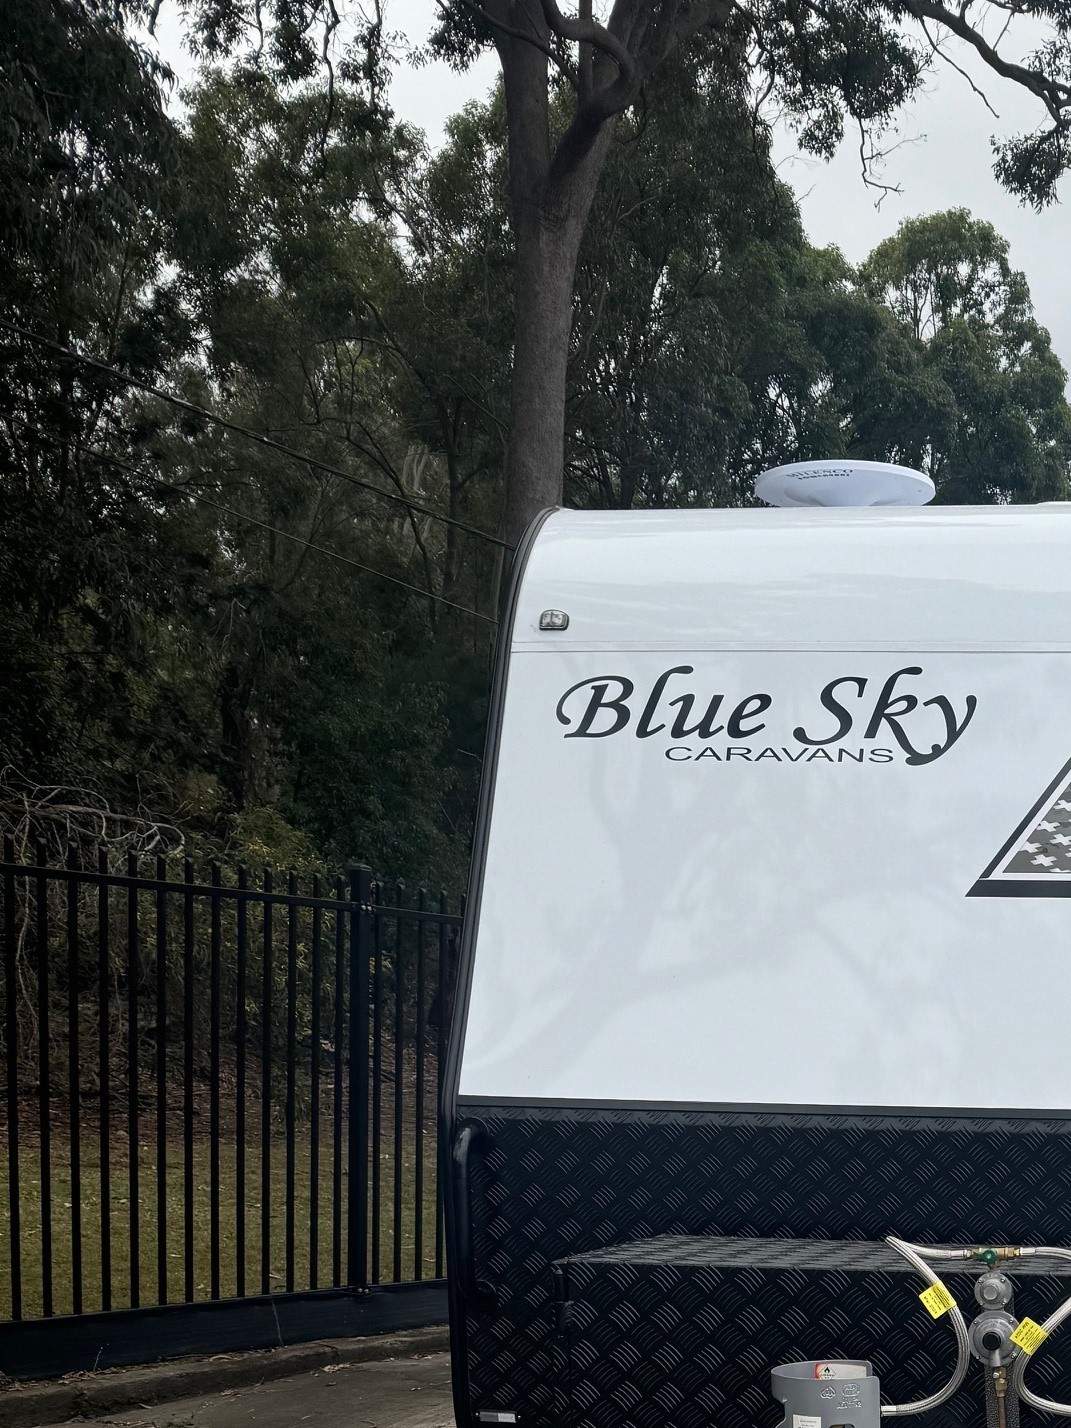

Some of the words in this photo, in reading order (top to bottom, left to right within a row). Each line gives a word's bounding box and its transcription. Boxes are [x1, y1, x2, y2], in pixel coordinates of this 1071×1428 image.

[555, 665, 773, 739] Blue
[792, 666, 978, 766] Sky
[664, 746, 894, 764] CARAVANS
